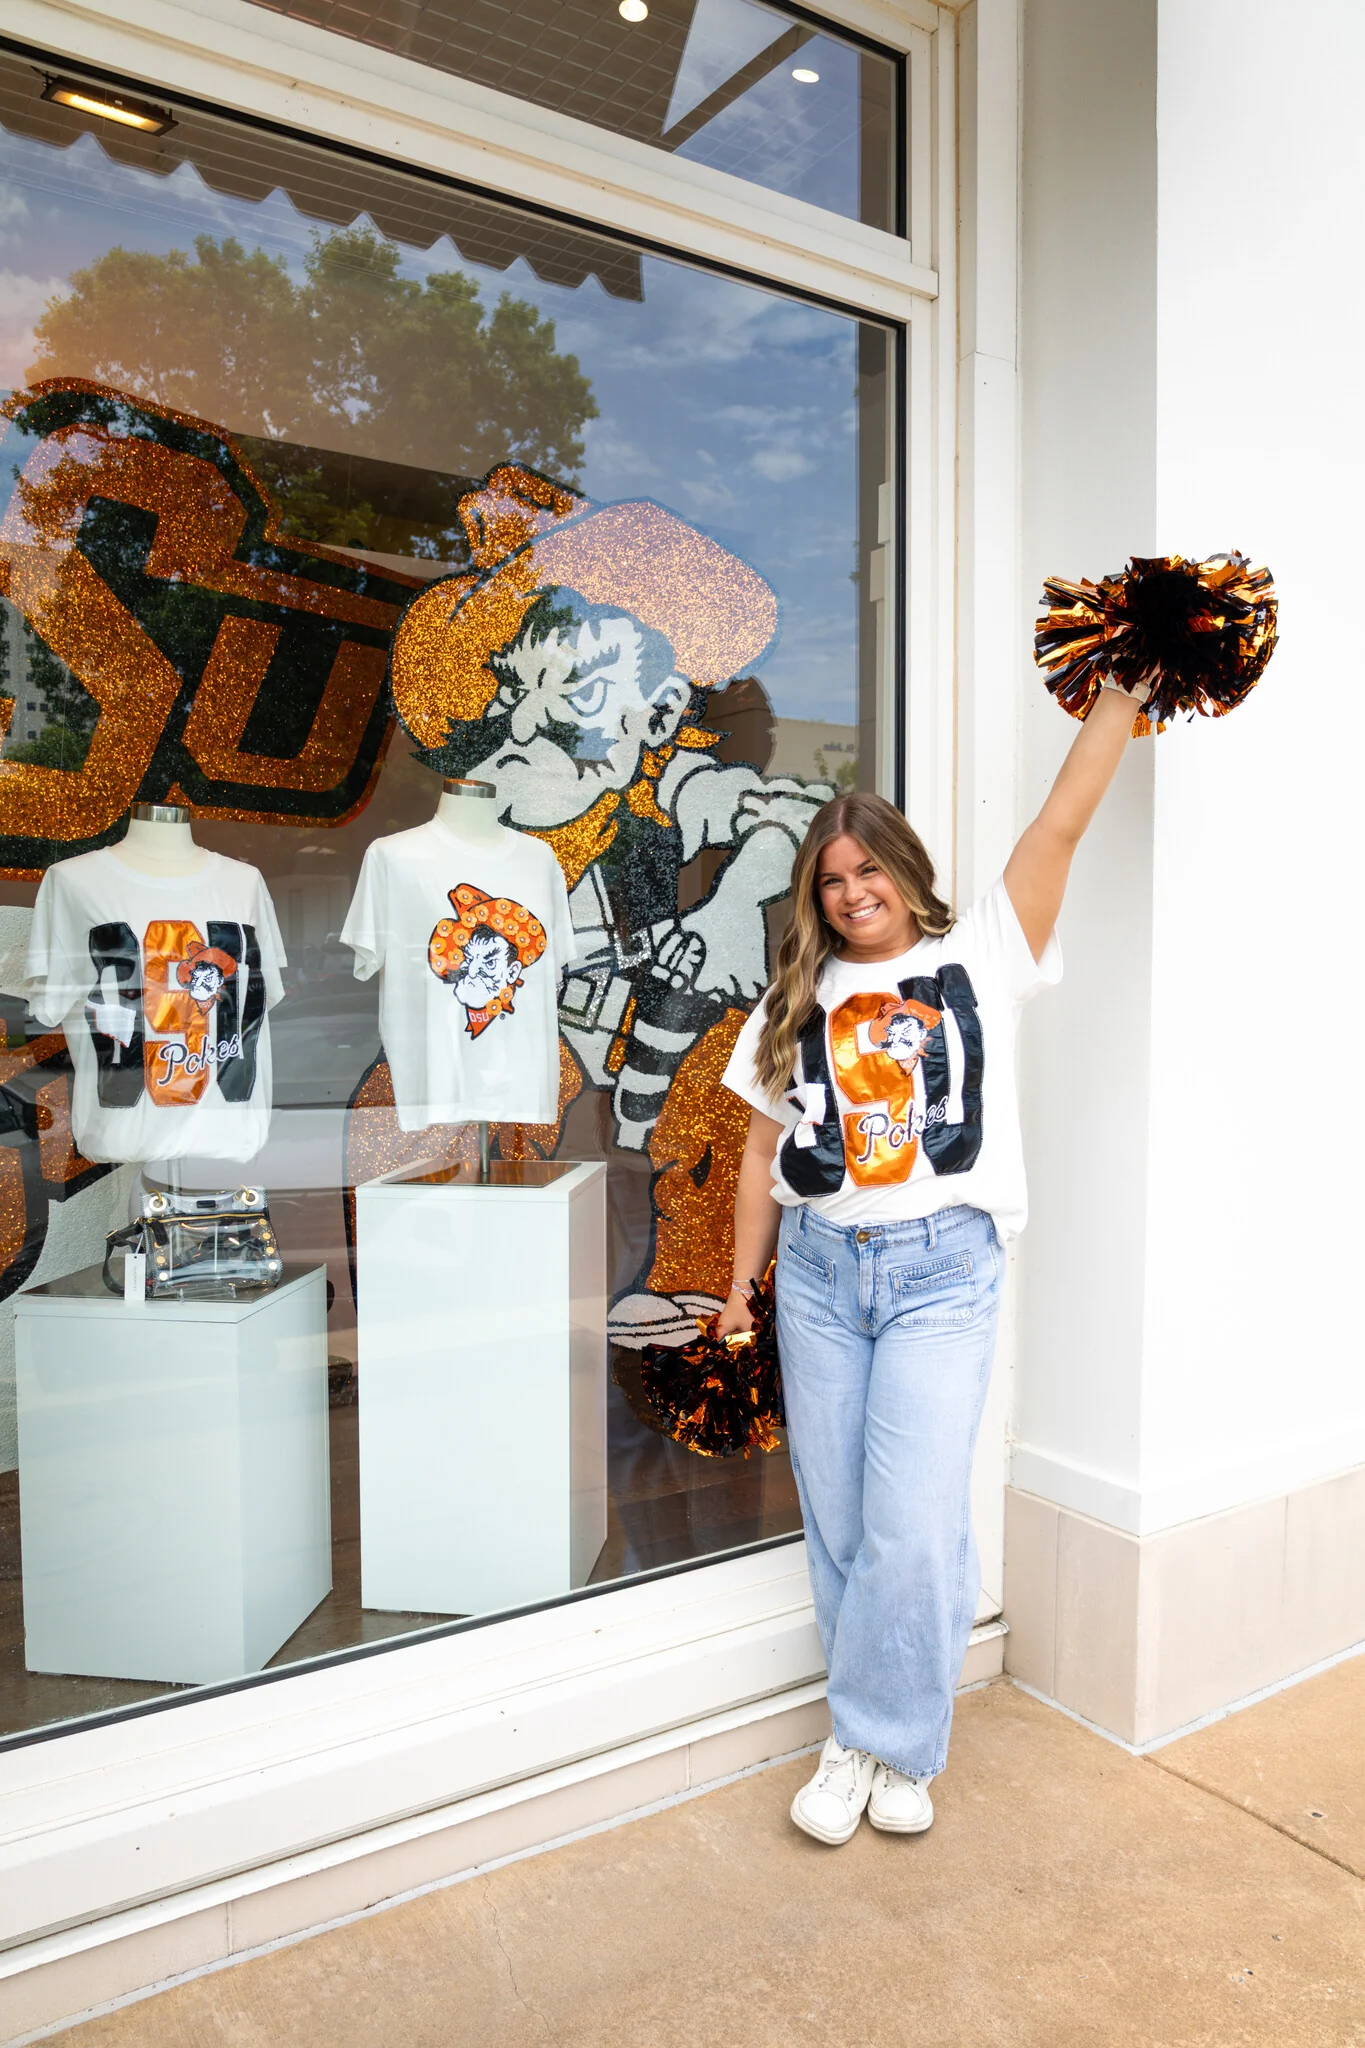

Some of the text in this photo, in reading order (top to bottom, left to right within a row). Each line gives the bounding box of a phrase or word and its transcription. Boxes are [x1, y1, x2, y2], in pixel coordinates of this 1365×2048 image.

[468, 1011, 490, 1023] OSU
[157, 1034, 240, 1085] Pokes
[857, 1096, 948, 1164] Pokes
